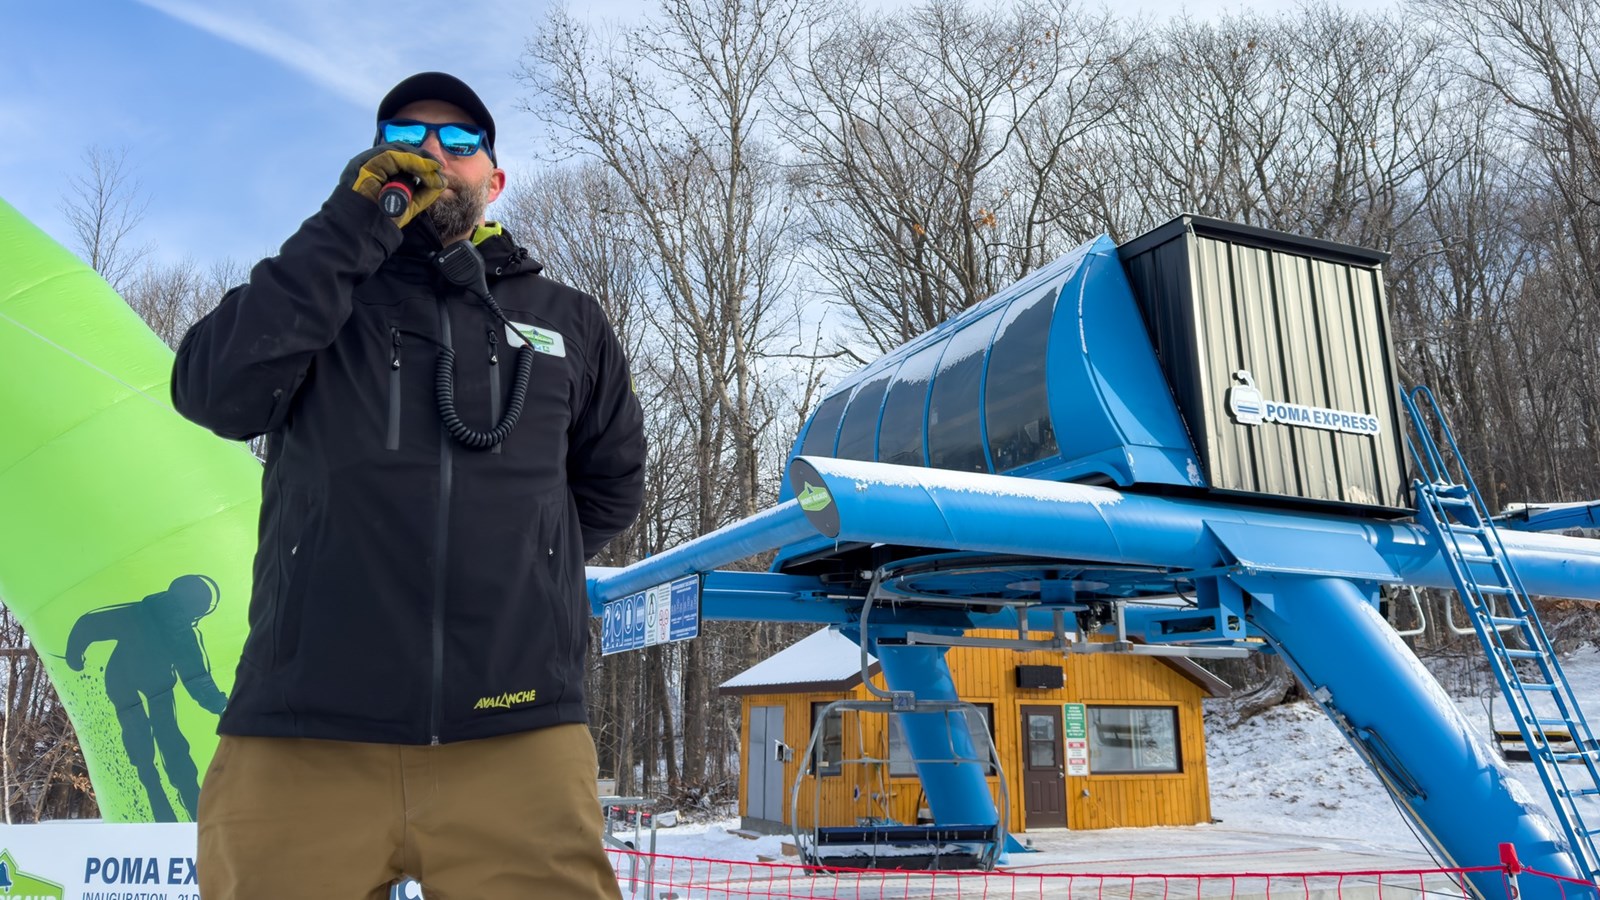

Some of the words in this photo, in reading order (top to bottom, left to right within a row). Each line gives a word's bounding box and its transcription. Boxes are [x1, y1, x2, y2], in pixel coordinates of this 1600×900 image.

[1266, 403, 1311, 424] POMA
[1313, 410, 1378, 432] EXPRESS
[473, 689, 536, 710] AVALANCHE
[84, 857, 160, 884] POMA
